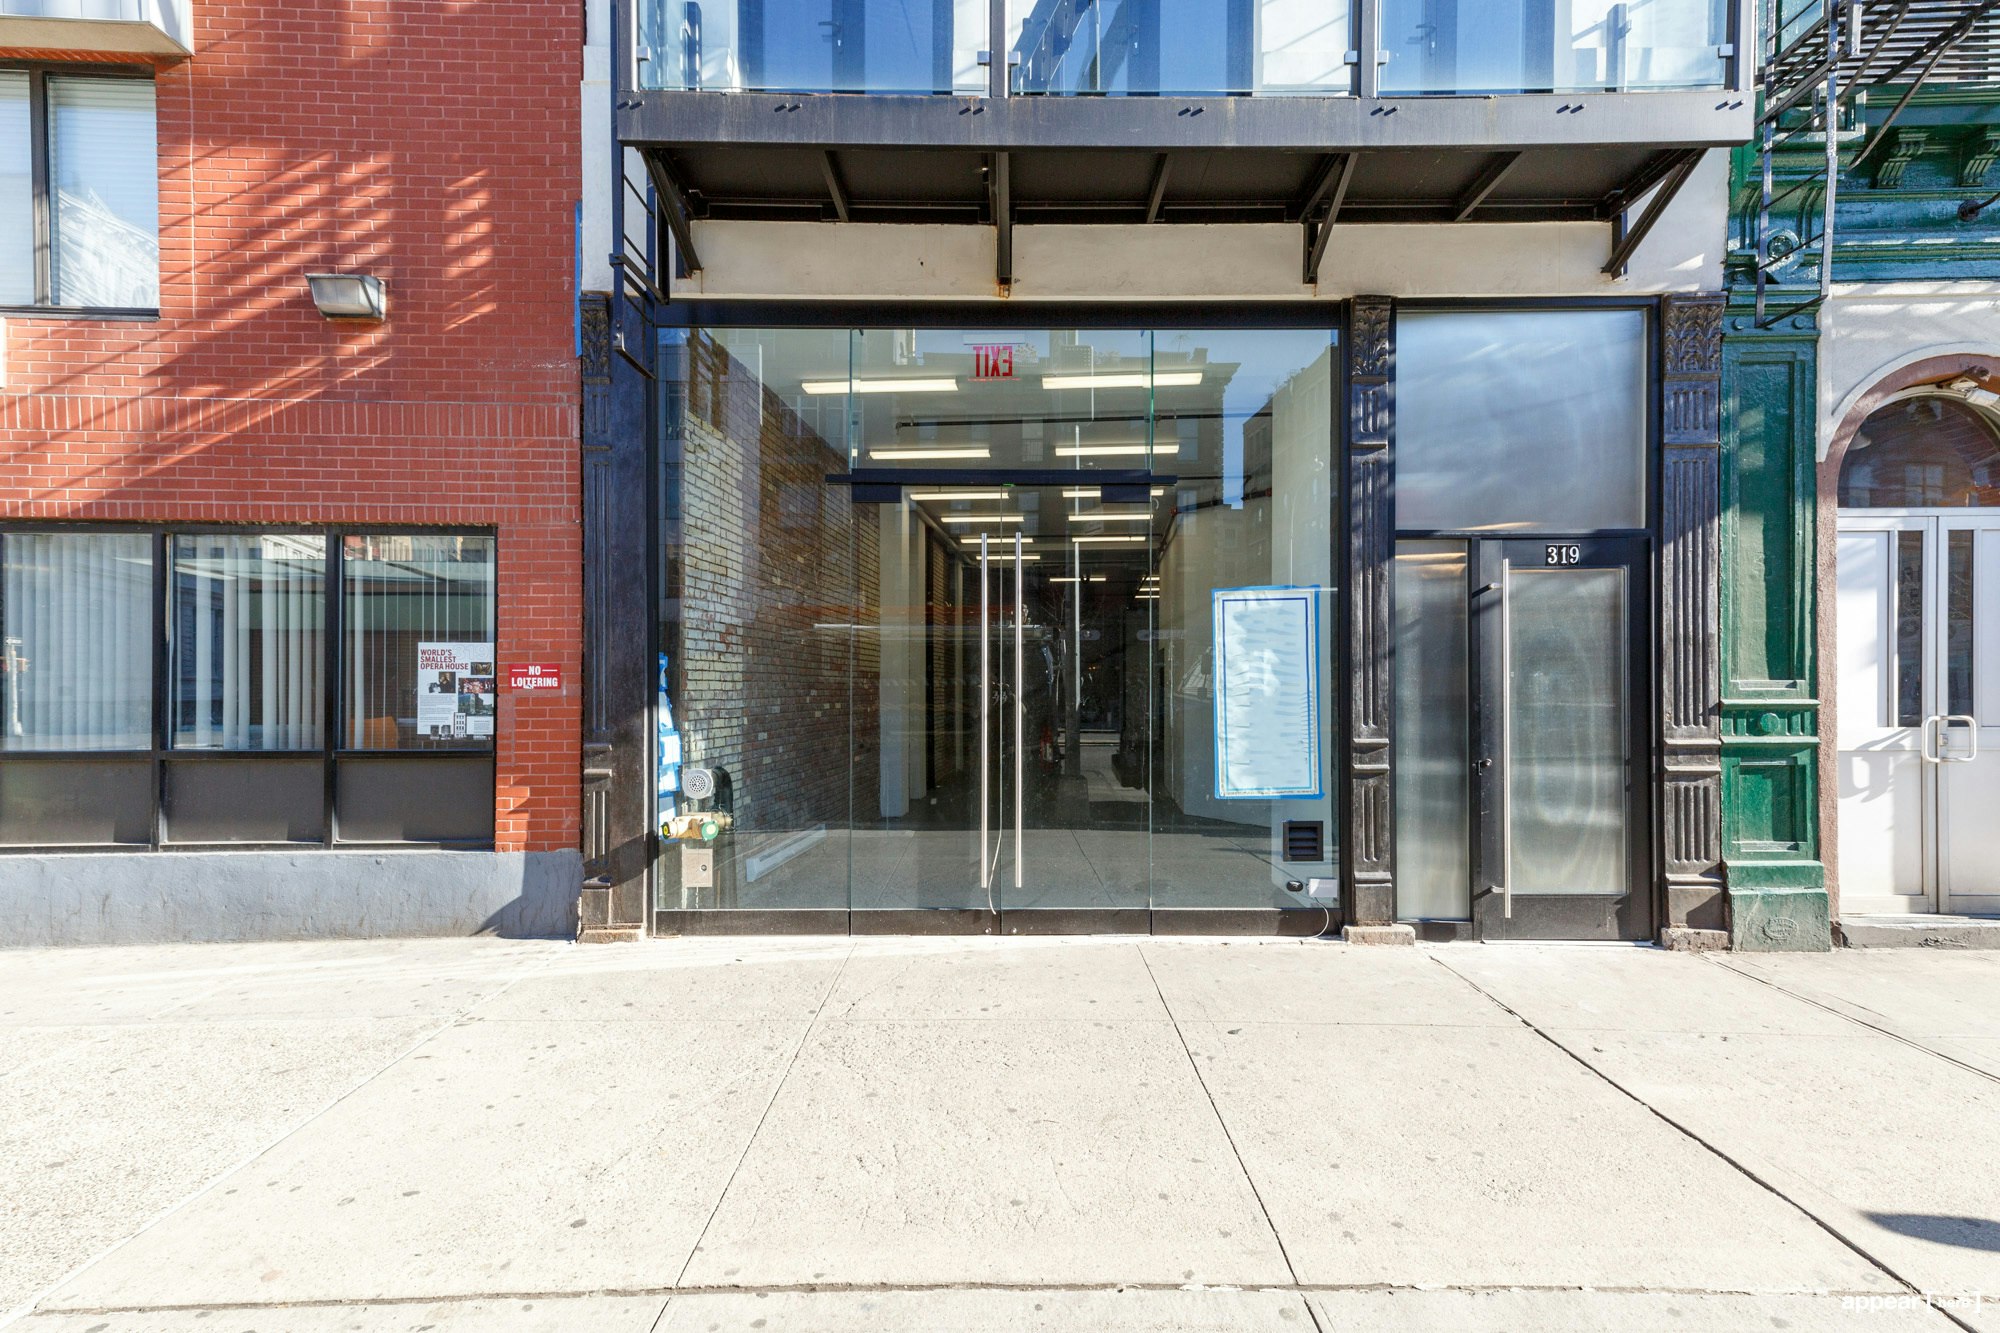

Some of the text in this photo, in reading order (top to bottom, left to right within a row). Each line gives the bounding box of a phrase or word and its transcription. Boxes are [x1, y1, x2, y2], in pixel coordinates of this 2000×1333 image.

[1548, 546, 1579, 563] 319
[528, 665, 541, 675] NO
[511, 677, 558, 688] LOITERING
